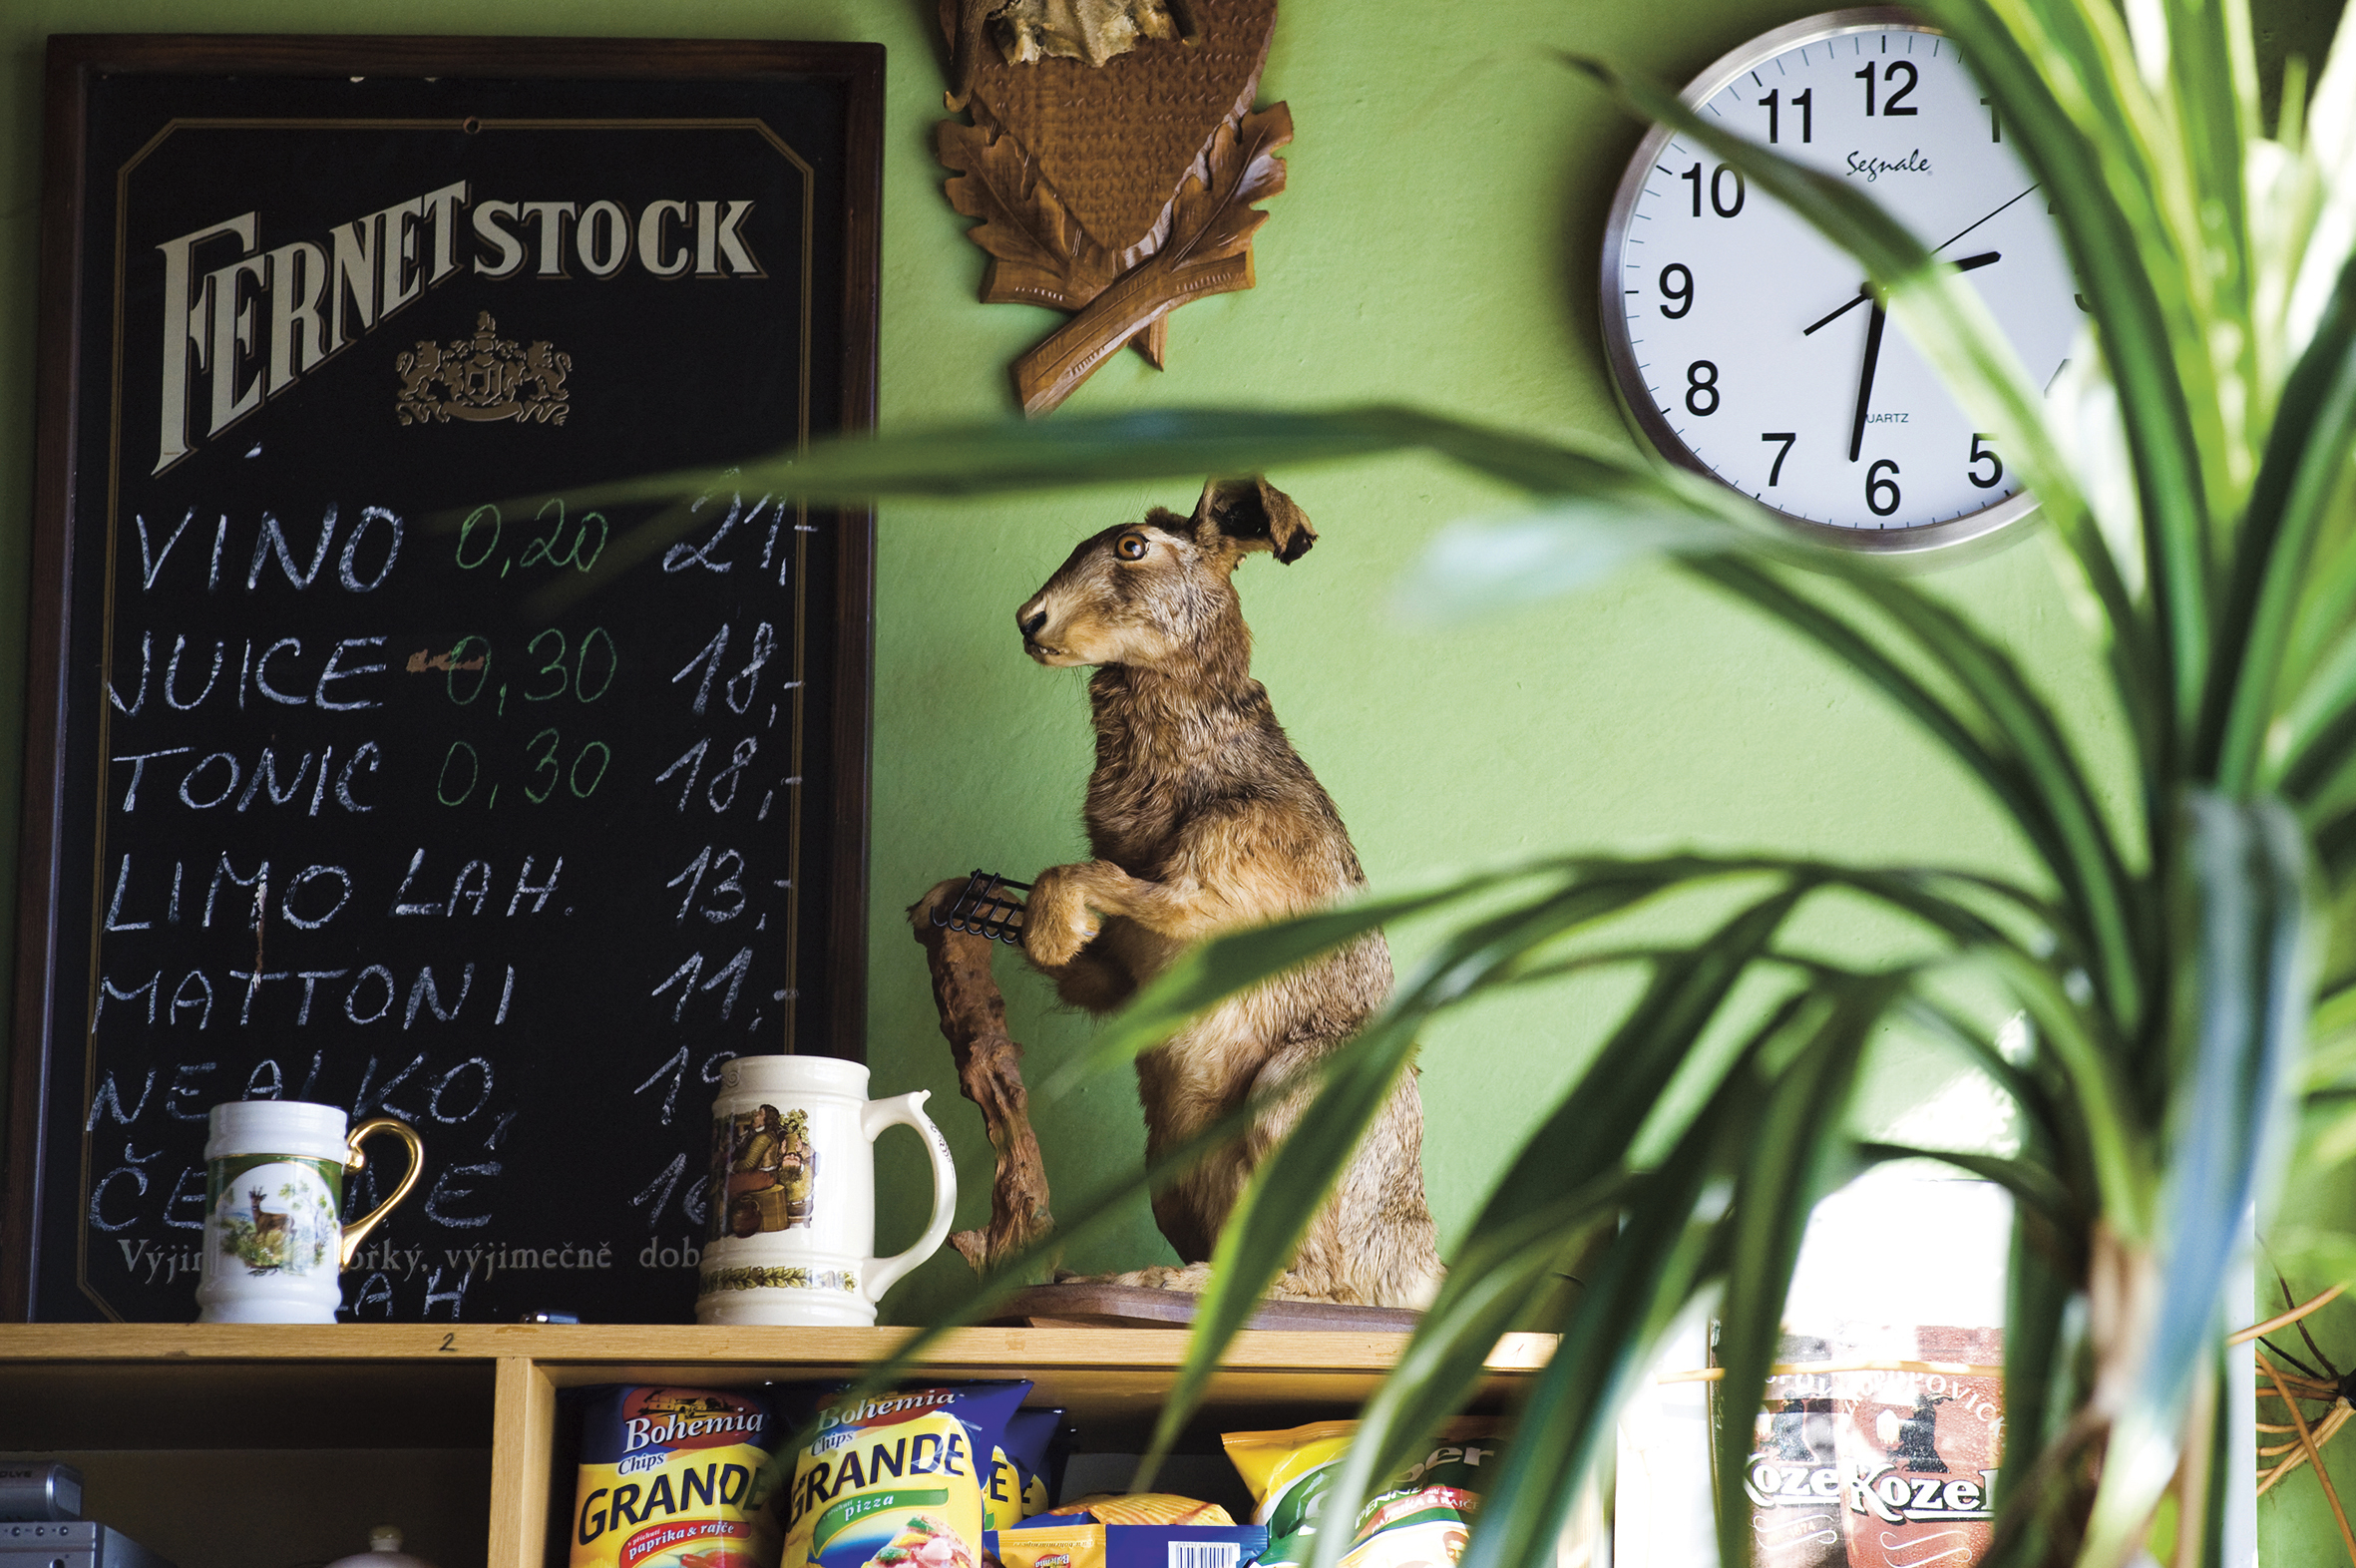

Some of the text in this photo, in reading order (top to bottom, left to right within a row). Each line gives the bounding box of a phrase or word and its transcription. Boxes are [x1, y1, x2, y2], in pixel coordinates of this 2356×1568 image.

[1758, 88, 1813, 144] 11
[1854, 60, 1919, 117] 12
[1681, 162, 1746, 218] 10
[1846, 148, 1933, 183] Segnale
[1658, 262, 1695, 319] 9
[151, 179, 767, 479] FERNET STOCK
[1685, 359, 1720, 417] 8
[1866, 412, 1909, 424] UARTZ
[1761, 432, 1796, 487] 7
[1864, 459, 1901, 516] 6
[1967, 432, 2004, 489] 5
[106, 630, 388, 720] JUICE
[112, 740, 381, 817] TONIC
[103, 849, 352, 932] LIMO
[92, 963, 515, 1035] MATTONI
[349, 1237, 427, 1283] ořký,
[444, 1241, 612, 1283] výjimečně
[638, 1235, 700, 1269] dob
[438, 1332, 459, 1352] 2
[622, 1406, 765, 1454] Bohemia
[815, 1388, 958, 1434] Bohemia
[617, 1452, 664, 1475] Chips
[810, 1430, 854, 1457] Chips
[844, 1493, 896, 1522] pizza
[628, 1519, 735, 1561] paprika & rajče
